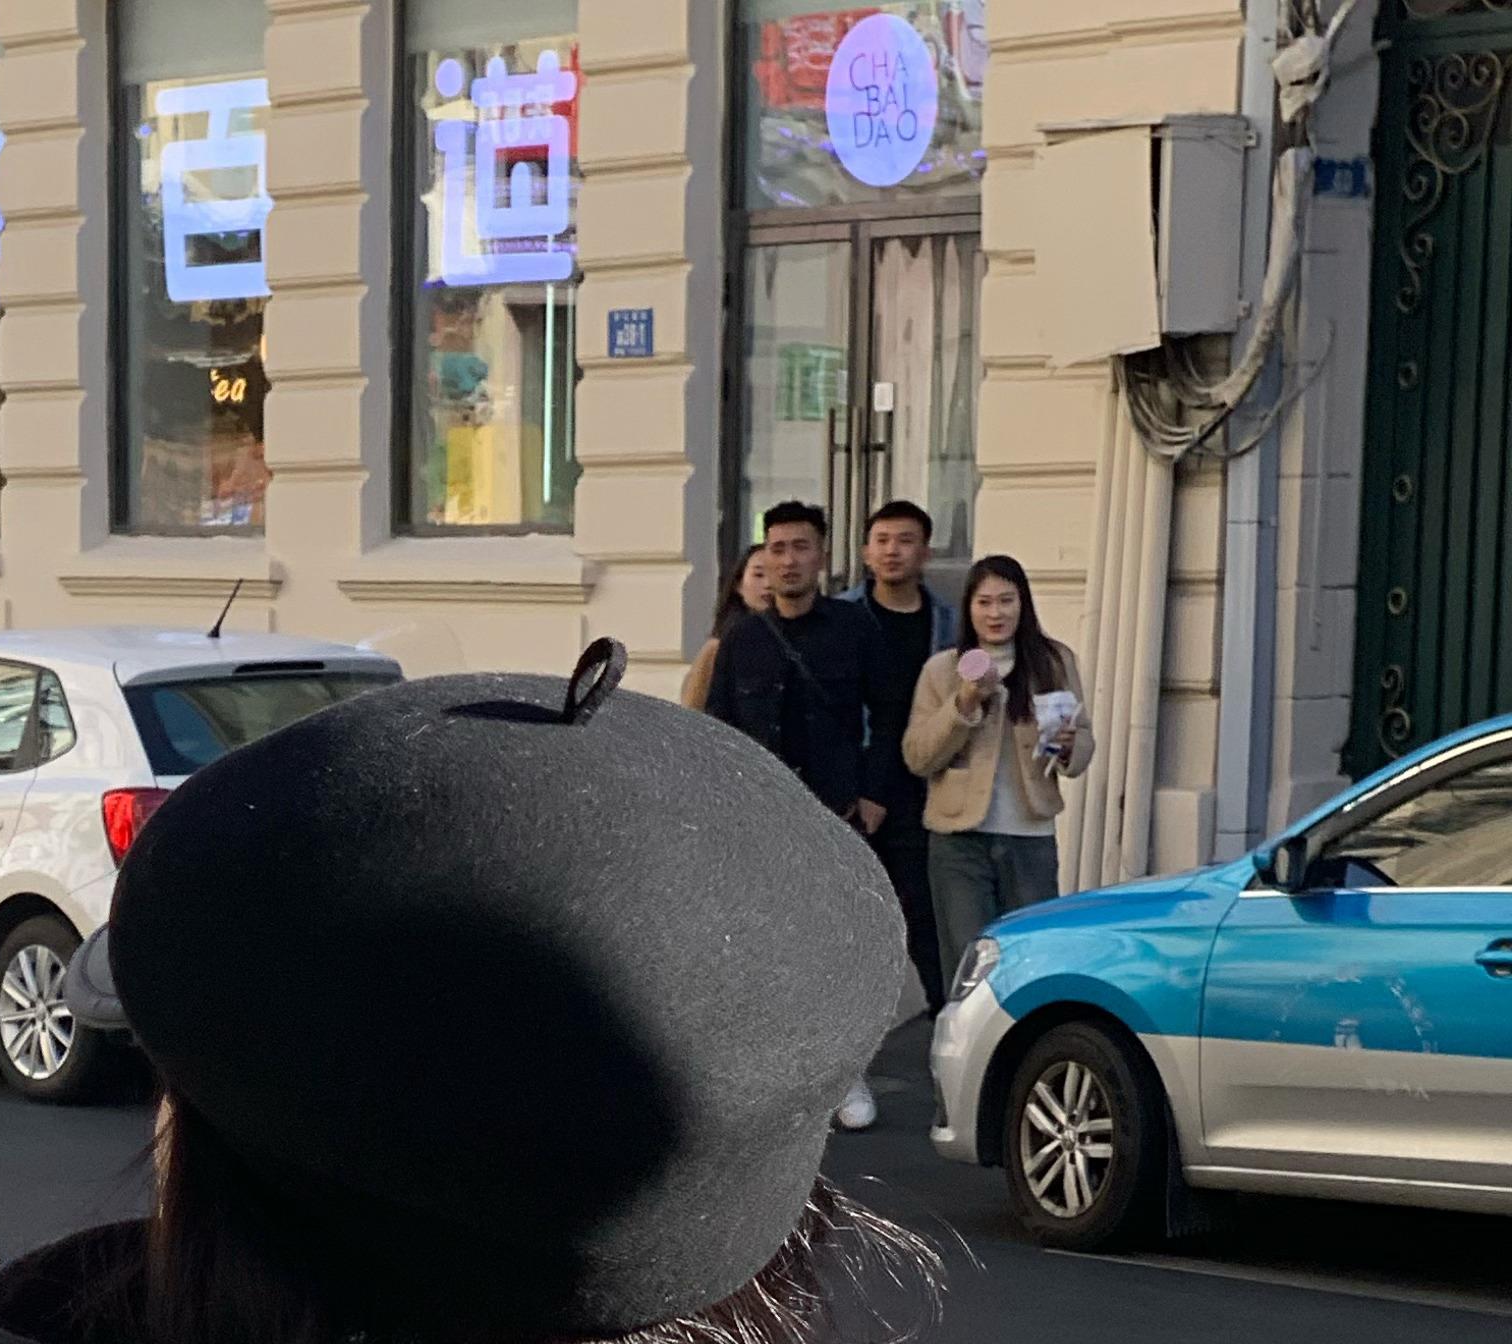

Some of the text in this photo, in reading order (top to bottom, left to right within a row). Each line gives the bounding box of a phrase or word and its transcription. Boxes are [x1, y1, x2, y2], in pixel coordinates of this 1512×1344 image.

[849, 50, 909, 92] CHA
[865, 82, 909, 117] BAI
[853, 109, 918, 148] DAO
[156, 78, 273, 302] 百
[435, 50, 577, 286] 道
